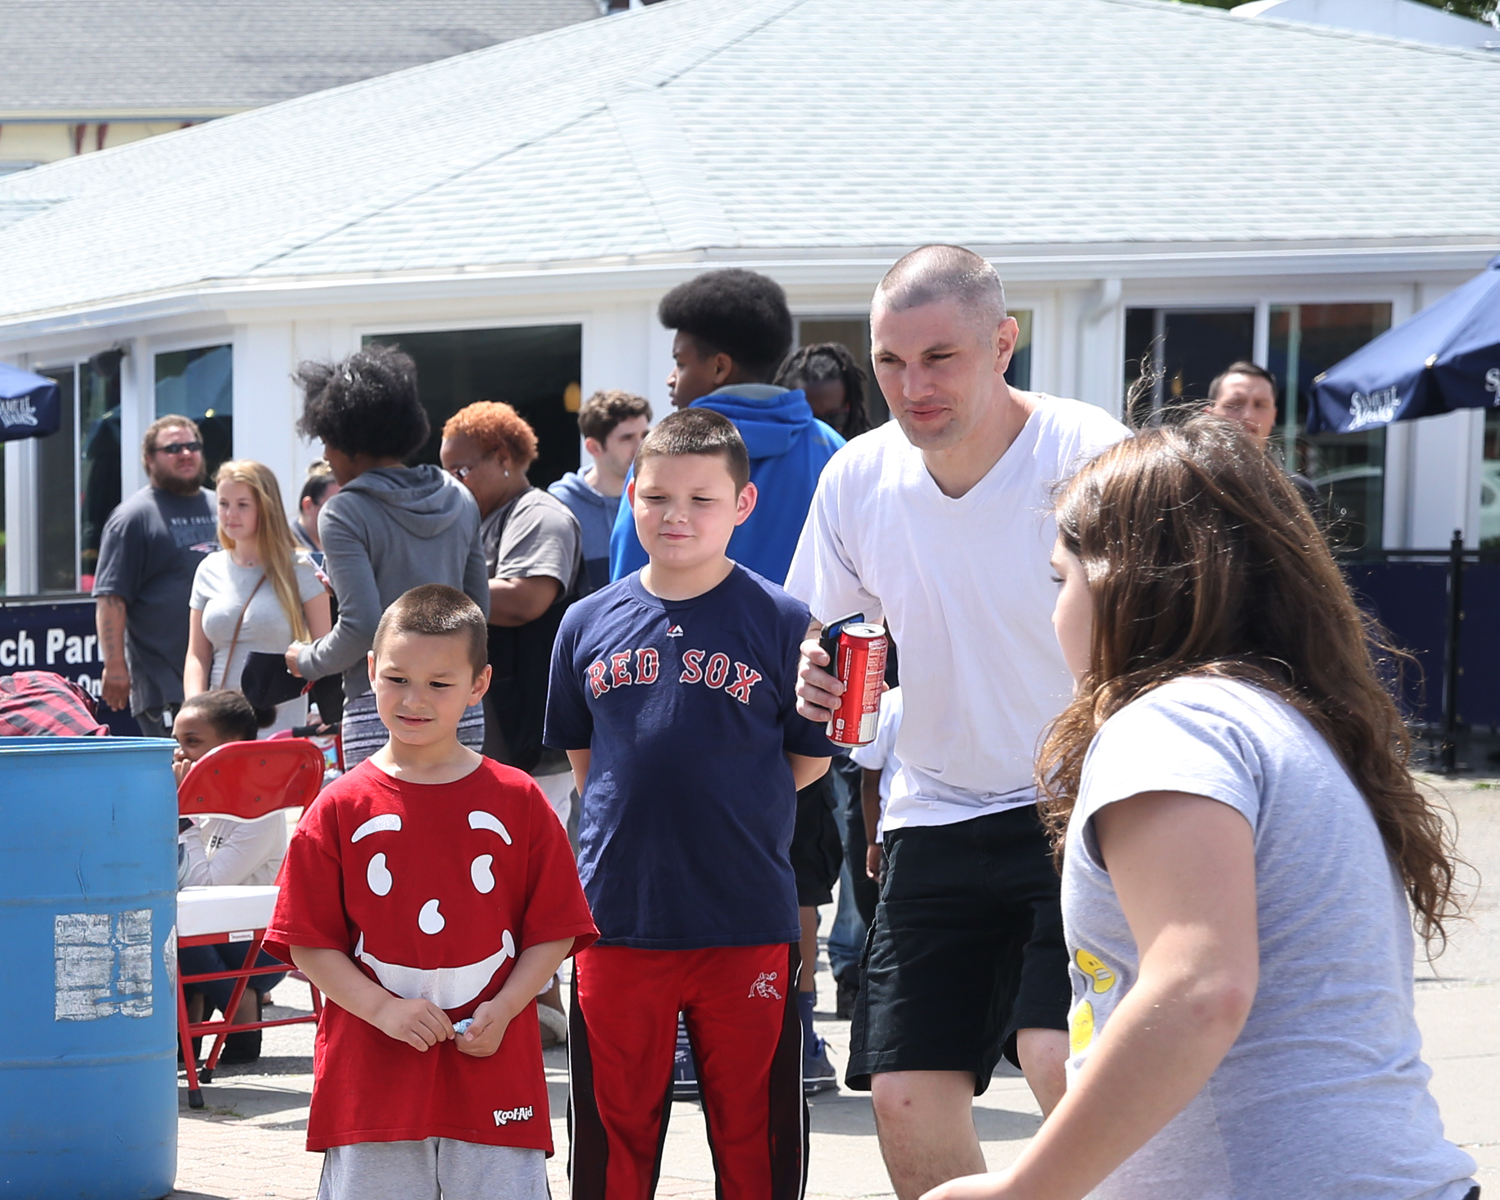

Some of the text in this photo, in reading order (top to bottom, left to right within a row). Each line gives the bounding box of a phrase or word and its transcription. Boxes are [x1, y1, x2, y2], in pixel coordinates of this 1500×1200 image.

[46, 628, 105, 665] Par
[588, 648, 763, 704] RED SOX
[493, 1105, 533, 1127] Kool-Aid
